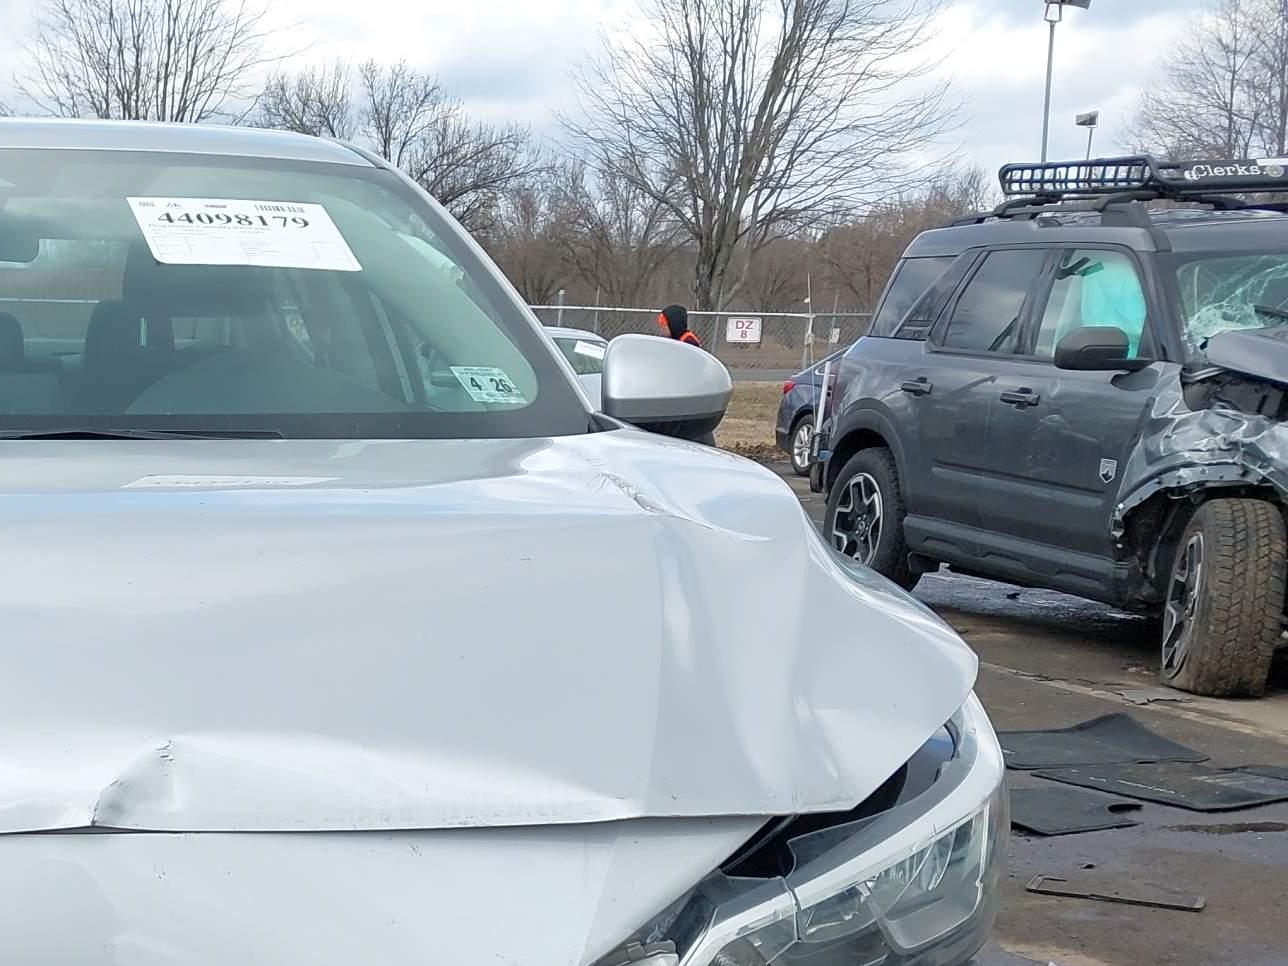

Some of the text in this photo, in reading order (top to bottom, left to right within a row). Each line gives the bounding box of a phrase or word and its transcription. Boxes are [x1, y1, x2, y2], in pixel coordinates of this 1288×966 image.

[157, 211, 310, 228] 44098179
[736, 320, 753, 329] DZ
[740, 330, 748, 339] 8
[470, 377, 513, 393] 4 26
